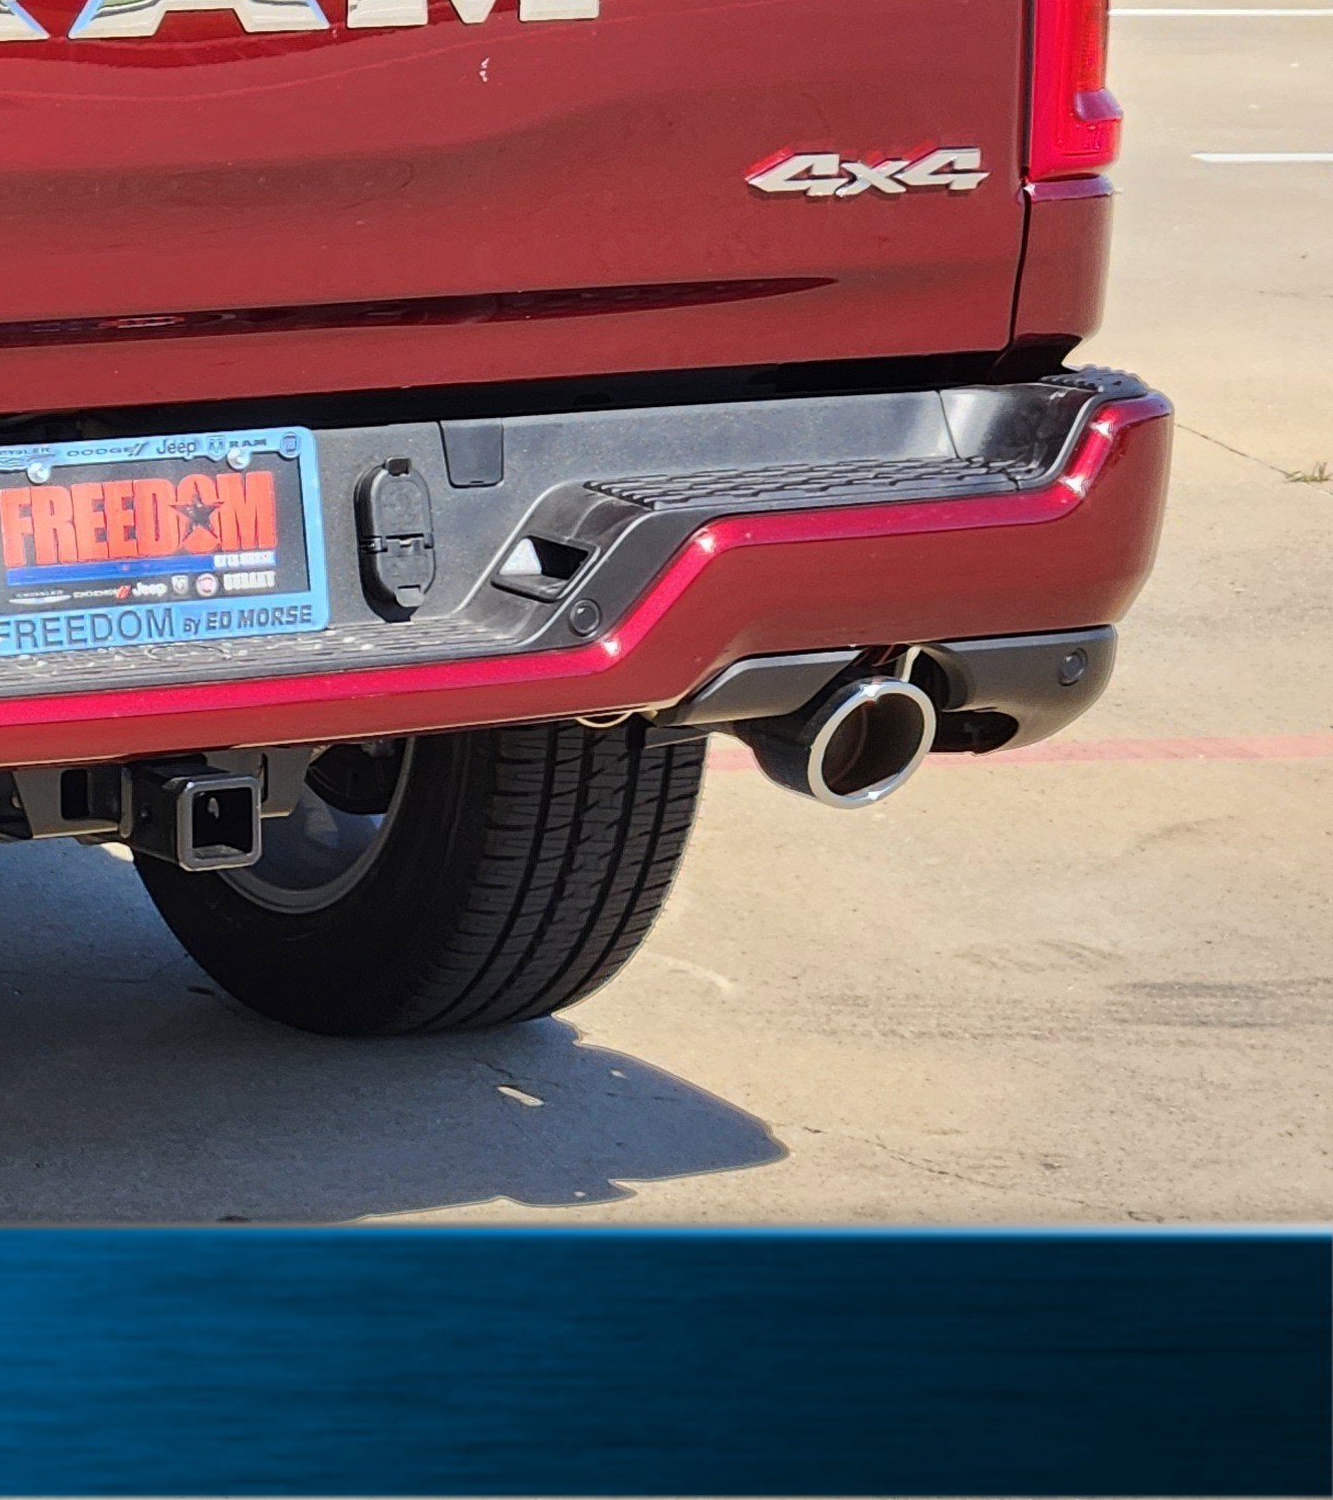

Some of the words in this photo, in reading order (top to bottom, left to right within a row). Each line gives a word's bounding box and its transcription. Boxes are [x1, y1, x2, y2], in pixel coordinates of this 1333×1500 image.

[156, 437, 197, 457] Jeep
[228, 438, 268, 449] RAM
[206, 610, 232, 631] ED
[237, 603, 313, 630] MORSE
